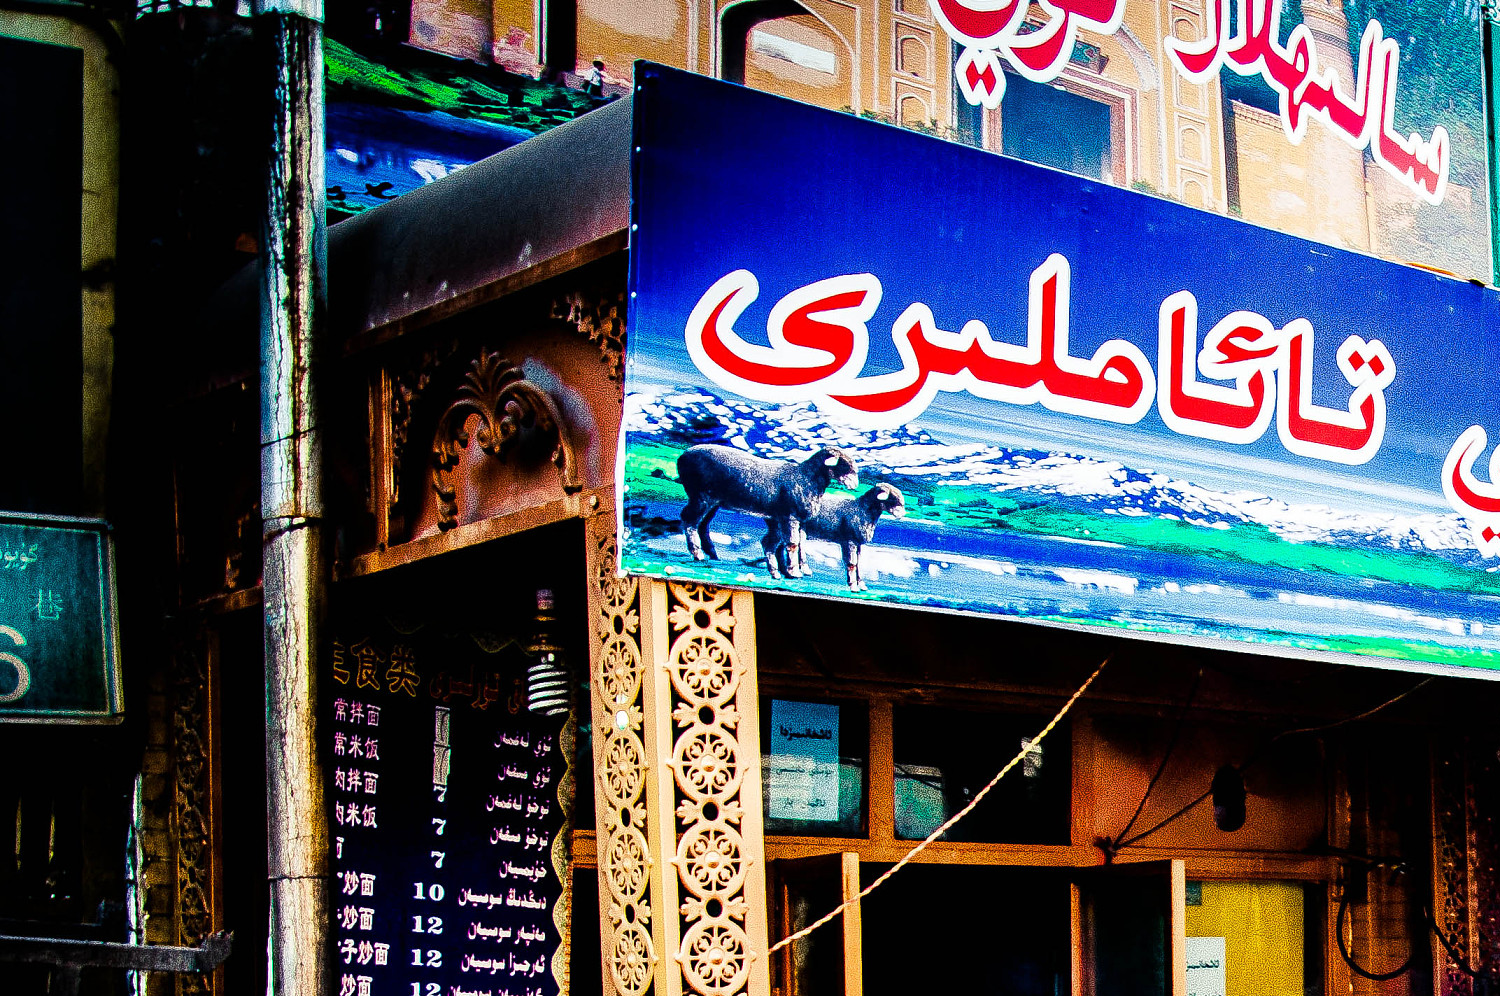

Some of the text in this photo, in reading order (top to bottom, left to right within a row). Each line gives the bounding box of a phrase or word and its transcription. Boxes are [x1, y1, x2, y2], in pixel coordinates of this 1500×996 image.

[686, 254, 1395, 464] تائاملىرى
[432, 785, 447, 804] 7
[432, 818, 447, 836] 7
[430, 851, 446, 869] 7
[336, 870, 377, 897] 炒面
[413, 882, 445, 902] 10
[337, 905, 375, 932] 炒面
[411, 915, 444, 935] 12
[337, 938, 391, 966] 子炒面
[411, 948, 443, 968] 12
